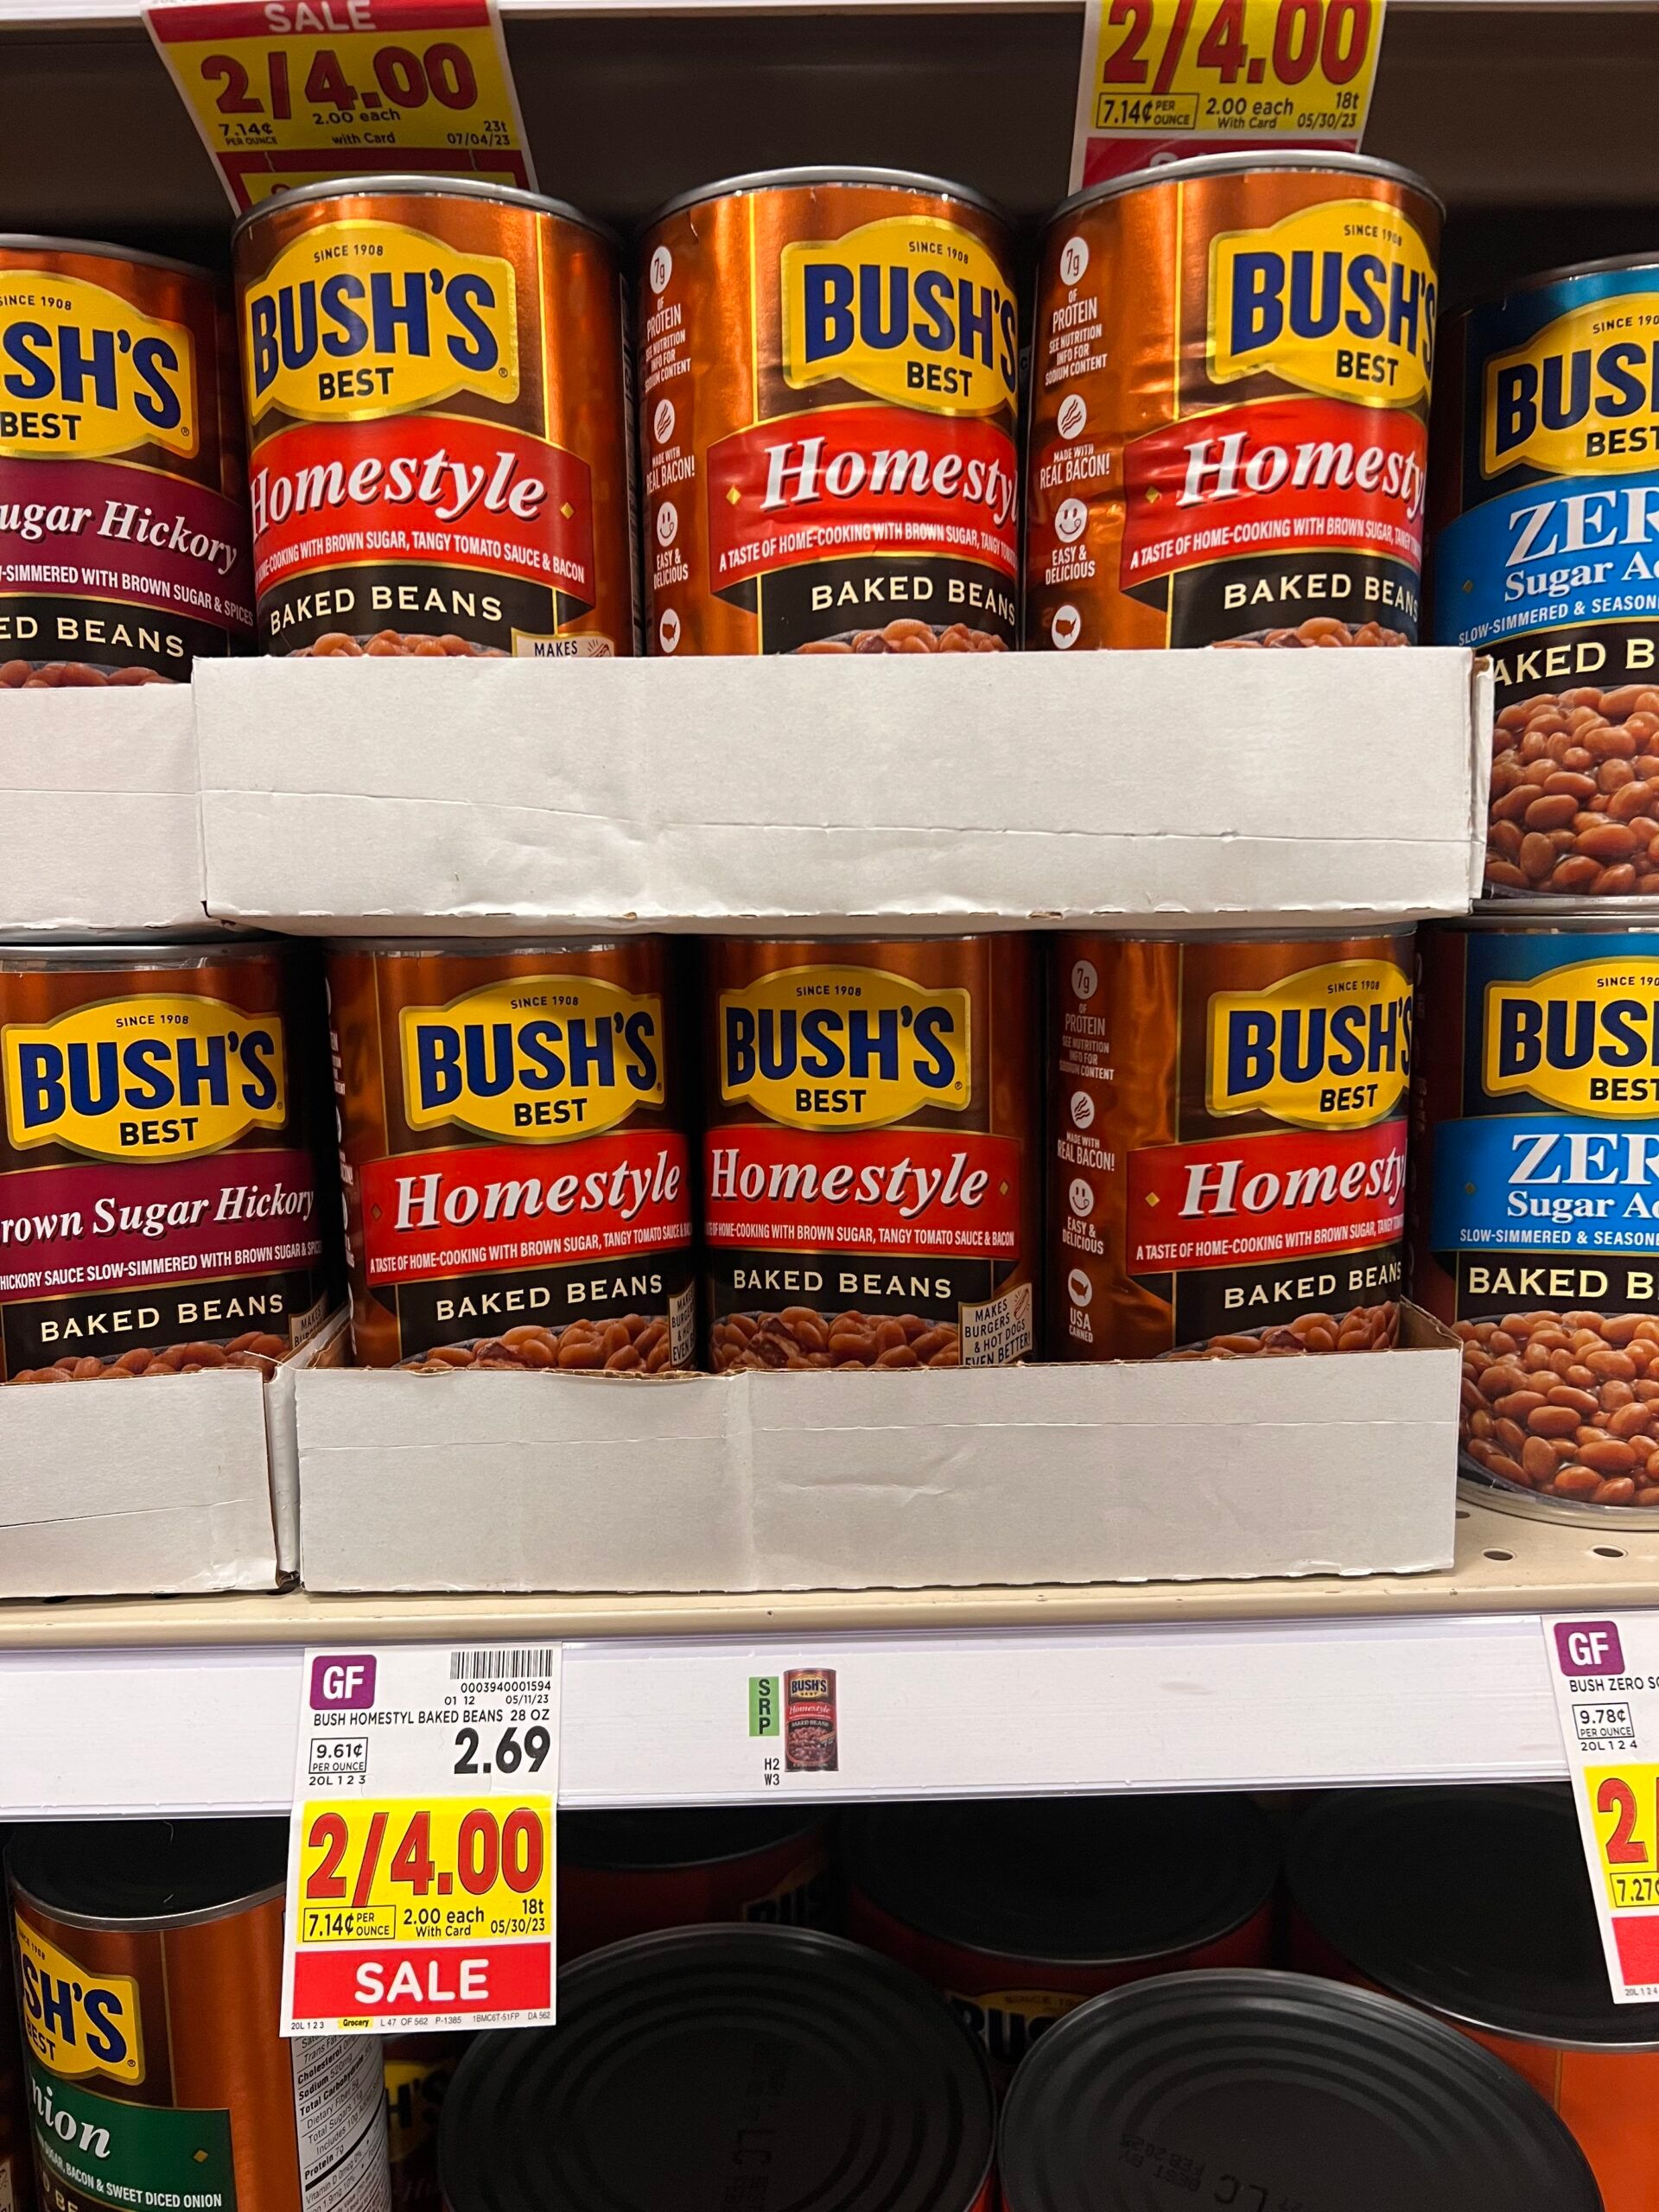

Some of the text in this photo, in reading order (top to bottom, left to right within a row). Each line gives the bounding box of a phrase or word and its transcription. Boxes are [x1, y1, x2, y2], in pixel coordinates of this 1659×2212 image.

[267, 0, 377, 33] SALE
[1103, 0, 1373, 94] 2/4.00
[200, 42, 478, 119] 2/4.00
[313, 109, 401, 125] 2.00 each
[1154, 114, 1190, 125] OUNCE
[1155, 100, 1175, 111] PER
[1205, 97, 1294, 117] 2.00 each
[1298, 112, 1357, 128] 05/30/23
[484, 121, 506, 132] 23t
[1217, 116, 1277, 128] With Card
[447, 133, 510, 146] 07/04/23
[1344, 224, 1378, 238] SINCE
[314, 245, 384, 263] SINCE 1908
[908, 240, 943, 255] SINCE
[41, 296, 73, 310] 1908
[1052, 296, 1097, 333] PROTEIN
[1230, 250, 1437, 380] BUSH'S
[251, 269, 499, 398] BUSH'S
[647, 303, 682, 341] PROTEIN
[804, 264, 1017, 394] BUSH'S
[1592, 316, 1633, 334] SINCE
[3, 321, 181, 430] SH'S
[906, 360, 973, 397] BEST
[1336, 349, 1399, 386] BEST
[318, 367, 394, 401] BEST
[1496, 342, 1659, 457] BUS
[0, 411, 81, 441] BEST
[1053, 448, 1072, 462] MADE
[760, 436, 1017, 527] Homestyl
[1040, 464, 1063, 490] REAL
[251, 448, 547, 543] Homestyle
[97, 499, 238, 575] Hickory
[1141, 518, 1364, 566] TASTE HOME-COOKING WITH BROWN
[326, 531, 585, 584] BROWN TANGY TOMATO SAUCE BACON
[1052, 545, 1077, 566] EASY
[1046, 561, 1096, 586] DELICIOUS
[1505, 562, 1614, 602] Sugar
[81, 568, 212, 610] WITH BROWN SUGAR
[812, 575, 1015, 626] BAKED BEANS
[1224, 574, 1418, 622] BAKED BEANS
[270, 586, 503, 636] BAKED BEANS
[1459, 603, 1568, 646] SLOW-SIMMERED
[57, 617, 184, 658] BEANS
[796, 985, 861, 997] SINCE 1908
[1327, 981, 1357, 994] SINCE
[1597, 976, 1635, 988] SINCE
[510, 995, 580, 1010] SINCE 1908
[116, 1014, 189, 1028] SINCE 1908
[1065, 1014, 1105, 1036] PROTEIN
[726, 1005, 955, 1089] BUSH'S
[1228, 995, 1412, 1096] BUSH'S
[416, 1011, 658, 1110] BUSH'S
[18, 1029, 276, 1129] BUSH'S
[513, 1098, 588, 1128] BEST
[796, 1090, 867, 1113] BEST
[1319, 1084, 1378, 1113] BEST
[119, 1117, 199, 1147] BEST
[1509, 1133, 1659, 1185] ZER
[394, 1149, 682, 1220] Homestyle
[710, 1147, 988, 1218] Homestyle
[92, 1182, 315, 1237] Sugar Hickory
[1507, 1190, 1615, 1224] Sugar
[797, 1226, 912, 1243] BROWN TANGY
[1063, 1229, 1104, 1255] DELICIOUS
[1196, 1234, 1282, 1256] HOME-COOKING
[1460, 1229, 1571, 1244] SLOW-SIMMERED
[488, 1238, 562, 1262] WITH BROWN
[45, 1246, 273, 1286] SAUCE SLOW-SIMMERED WITH BROWN
[734, 1269, 951, 1299] BAKED BEANS
[1224, 1262, 1402, 1308] BAKED BEANS
[1469, 1268, 1608, 1297] BAKED
[436, 1274, 663, 1321] BAKED BEANS
[41, 1294, 283, 1342] BAKED BEANS
[963, 1313, 1011, 1338] BURGERS
[983, 1334, 1002, 1351] HOT
[997, 1332, 1032, 1363] BETTER!
[1568, 1632, 1609, 1666] GF
[322, 1665, 365, 1700] GF
[461, 1681, 551, 1694] 0003940001594
[791, 1680, 827, 1694] BUSH'S
[1569, 1677, 1644, 1693] BUSH ZERO
[464, 1695, 475, 1706] 12
[505, 1694, 549, 1705] 05/11/23
[314, 1709, 550, 1726] BUSH HOMESTYL BAKED BEANS 28 OZ
[1580, 1709, 1626, 1725] 9.78¢
[454, 1726, 551, 1774] 2.69
[332, 1761, 365, 1771] OUNCE
[765, 1774, 779, 1785] W3
[306, 1807, 544, 1908] 2/4.00
[357, 1912, 374, 1923] PER
[404, 1906, 484, 1925] 2.00 each
[522, 1898, 543, 1915] 18t
[356, 1925, 390, 1936] OUNCE
[416, 1925, 471, 1937] With Card
[490, 1918, 545, 1934] 05/30/23
[353, 1958, 490, 2005] SALE
[22, 1954, 127, 2063] SH'S
[435, 2016, 462, 2024] P-1385
[298, 2050, 342, 2084] Cholesterol
[299, 2076, 328, 2101] Sodium
[300, 2098, 321, 2116] Total
[324, 2055, 364, 2100] Carbohydrate
[307, 2107, 333, 2129] Dietary
[329, 2106, 352, 2129] Sugars
[316, 2128, 346, 2155] Includes
[305, 2154, 334, 2180] Protein
[146, 2191, 222, 2209] DICED ONION
